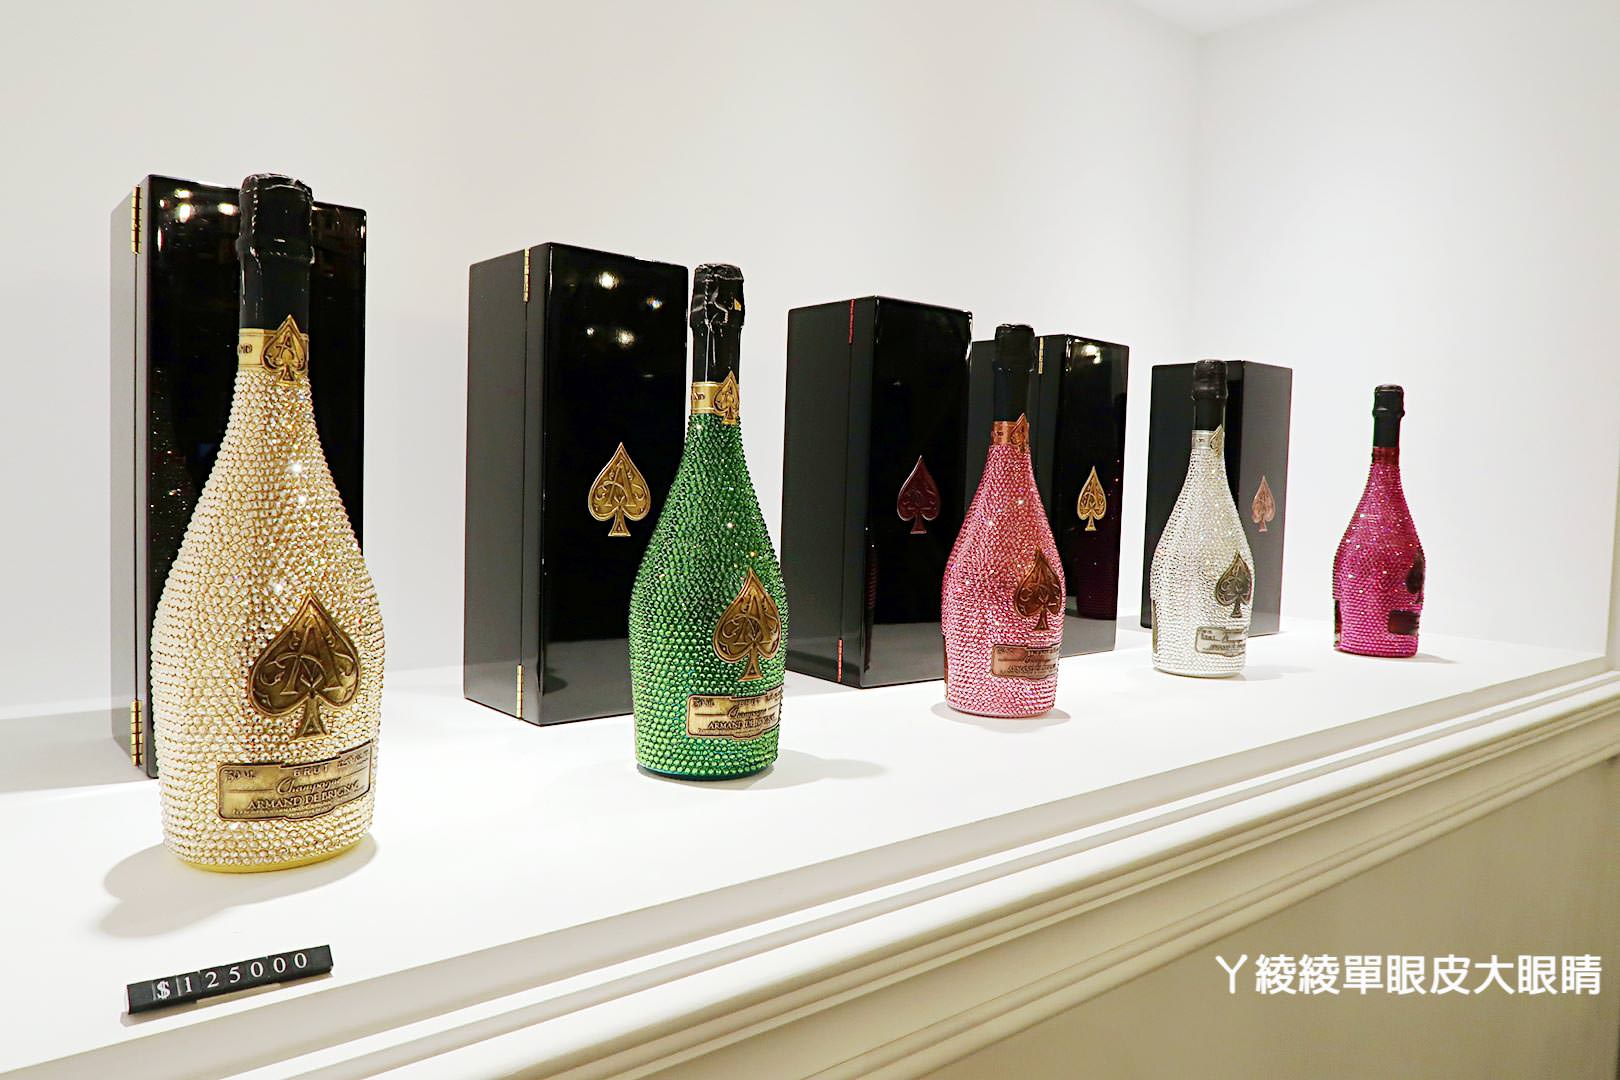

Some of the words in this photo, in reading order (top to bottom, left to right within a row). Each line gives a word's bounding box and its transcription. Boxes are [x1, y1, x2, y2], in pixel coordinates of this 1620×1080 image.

[277, 776, 342, 796] Champagne
[248, 794, 304, 811] ARMAND
[304, 792, 321, 805] DE
